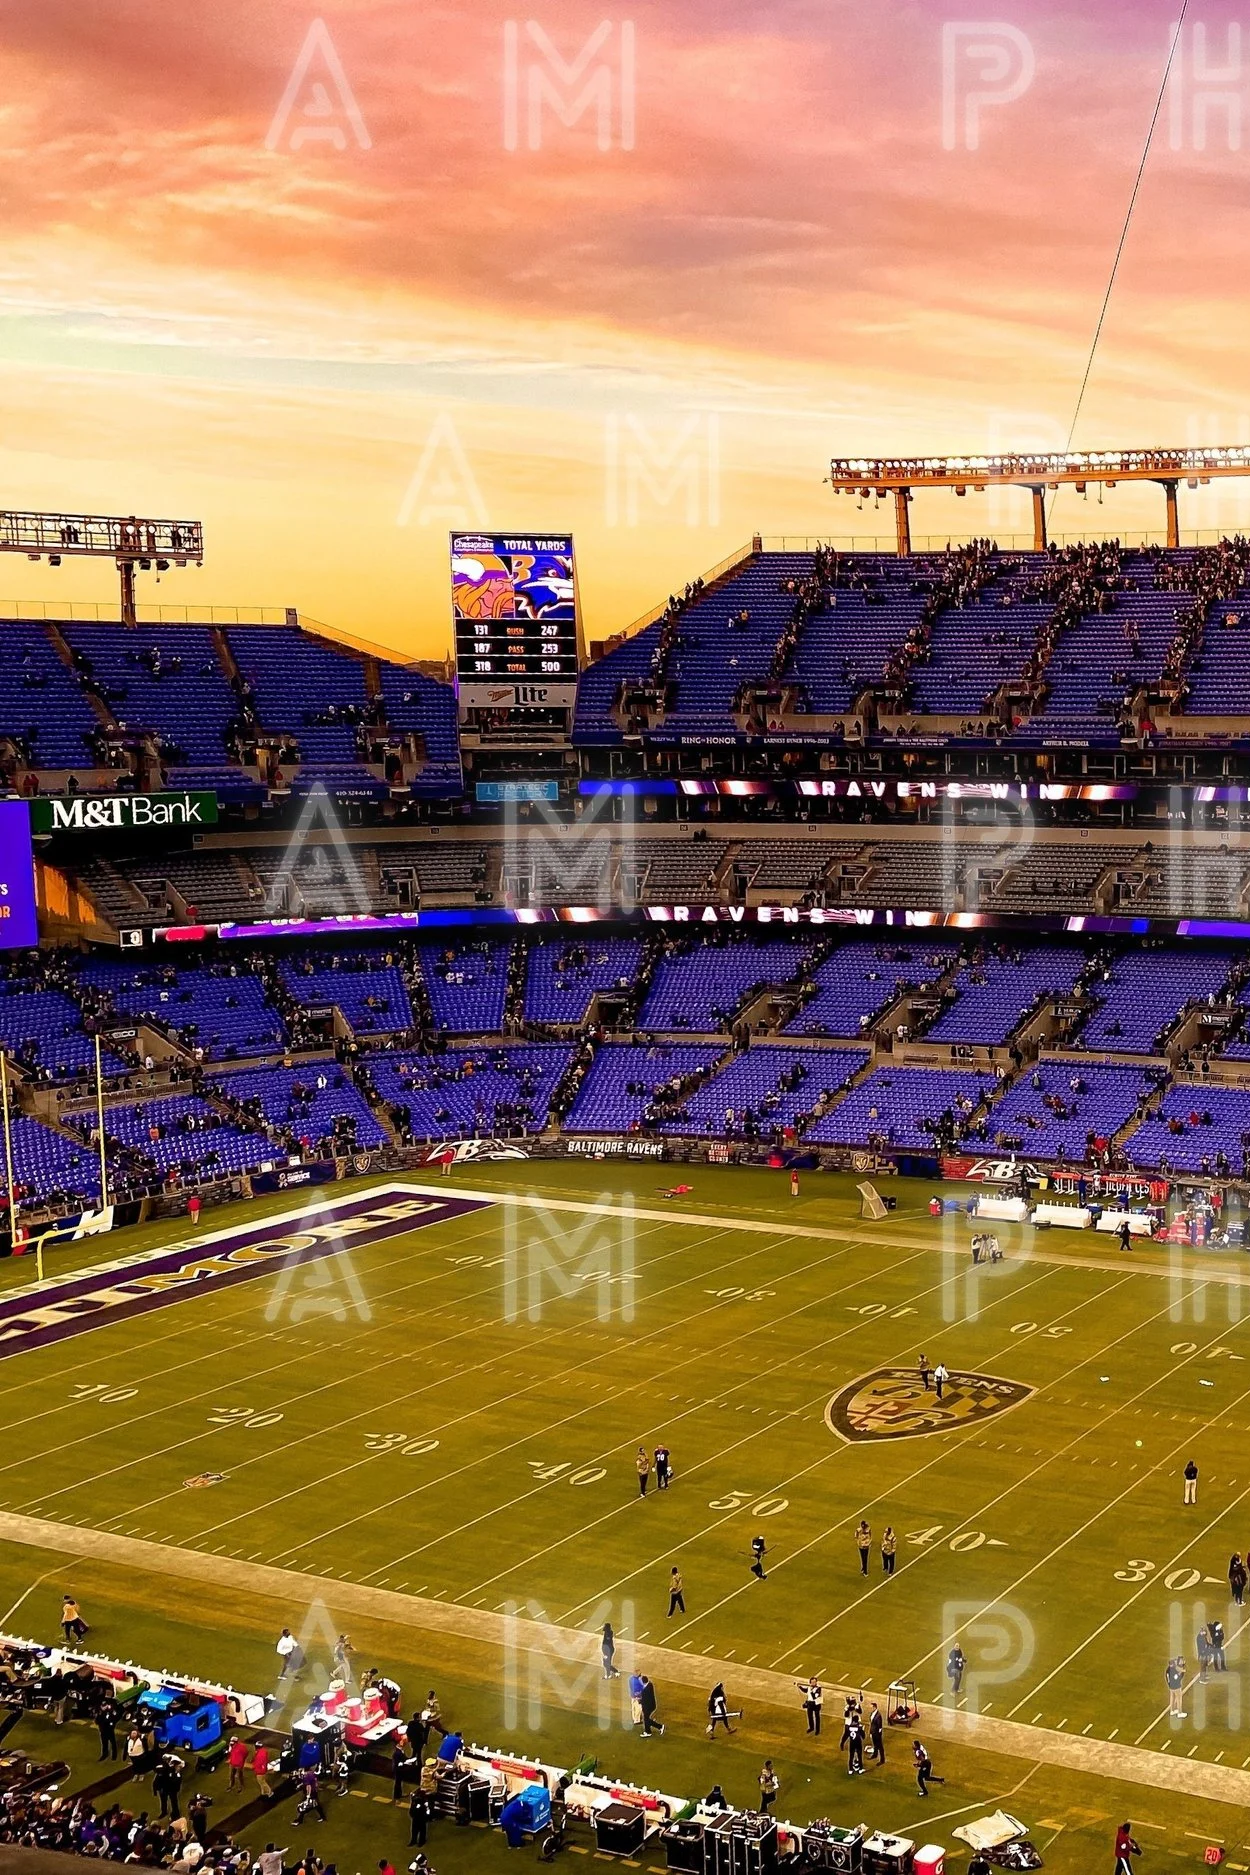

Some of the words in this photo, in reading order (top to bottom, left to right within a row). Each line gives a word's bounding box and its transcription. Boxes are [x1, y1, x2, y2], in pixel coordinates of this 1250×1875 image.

[503, 540, 532, 551] TOTAL
[535, 540, 565, 551] YARDS
[474, 625, 488, 635] 131
[507, 627, 524, 635] RUSH
[541, 625, 558, 636] 247
[507, 645, 525, 654] PASS
[541, 643, 558, 654] 253
[474, 661, 491, 671] 318
[507, 663, 526, 672] TOTAL
[541, 661, 560, 672] 500
[513, 685, 548, 706] Lite
[681, 736, 701, 745] RING
[706, 736, 736, 745] HONOR
[822, 780, 961, 799] RAVENS
[991, 783, 1054, 800] WIN
[50, 798, 129, 829] M&T
[131, 793, 202, 826] Bank
[673, 905, 825, 925] RAVENS
[854, 909, 921, 927] WIN
[568, 1140, 624, 1155] BALTIMORE
[626, 1142, 663, 1156] RAVENS
[708, 1490, 790, 1519] 50
[1113, 1558, 1202, 1593] 30
[1207, 1849, 1217, 1861] 20
